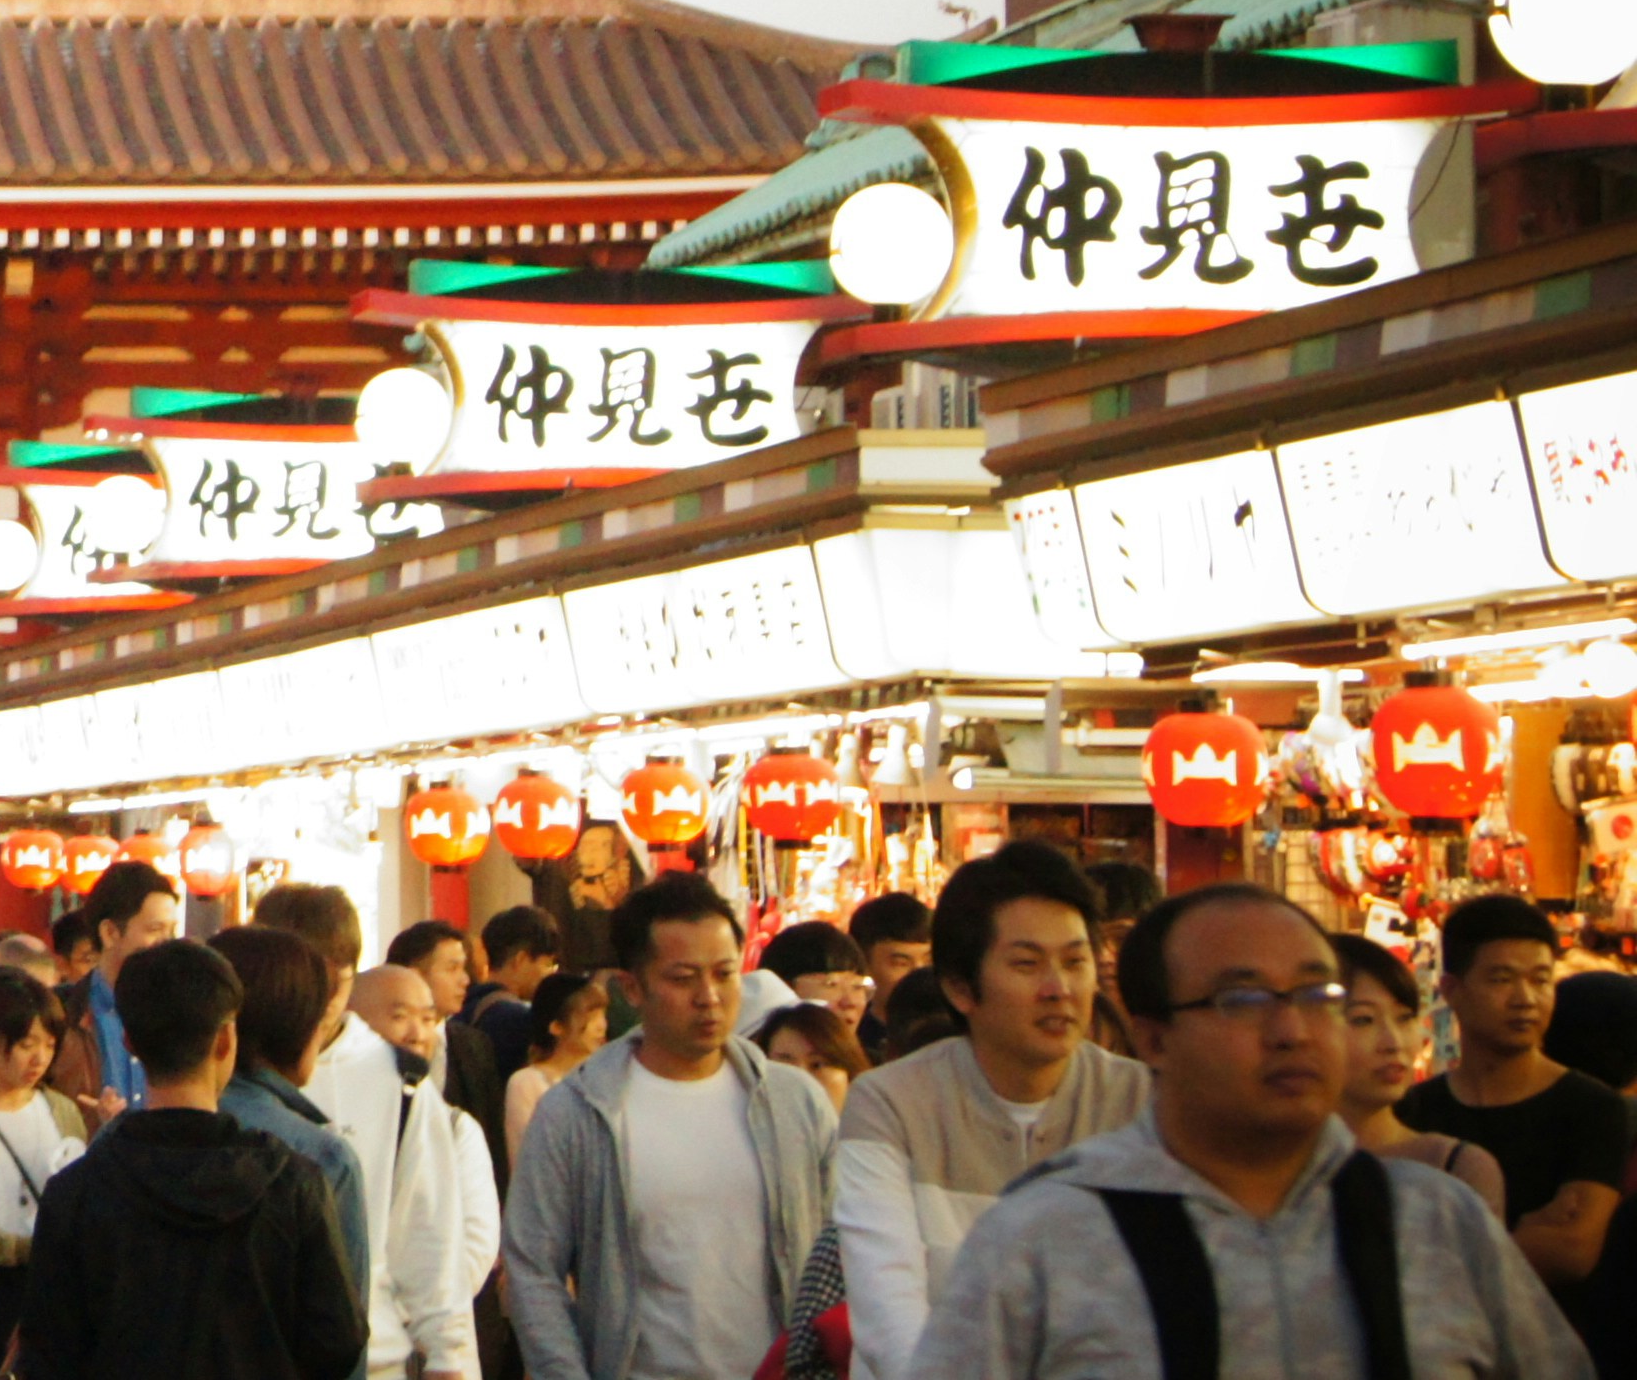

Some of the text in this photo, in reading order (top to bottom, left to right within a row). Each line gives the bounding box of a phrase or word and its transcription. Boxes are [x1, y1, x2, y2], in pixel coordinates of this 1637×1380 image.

[1002, 145, 1385, 287] 仲見世
[485, 344, 773, 448] 仲見世
